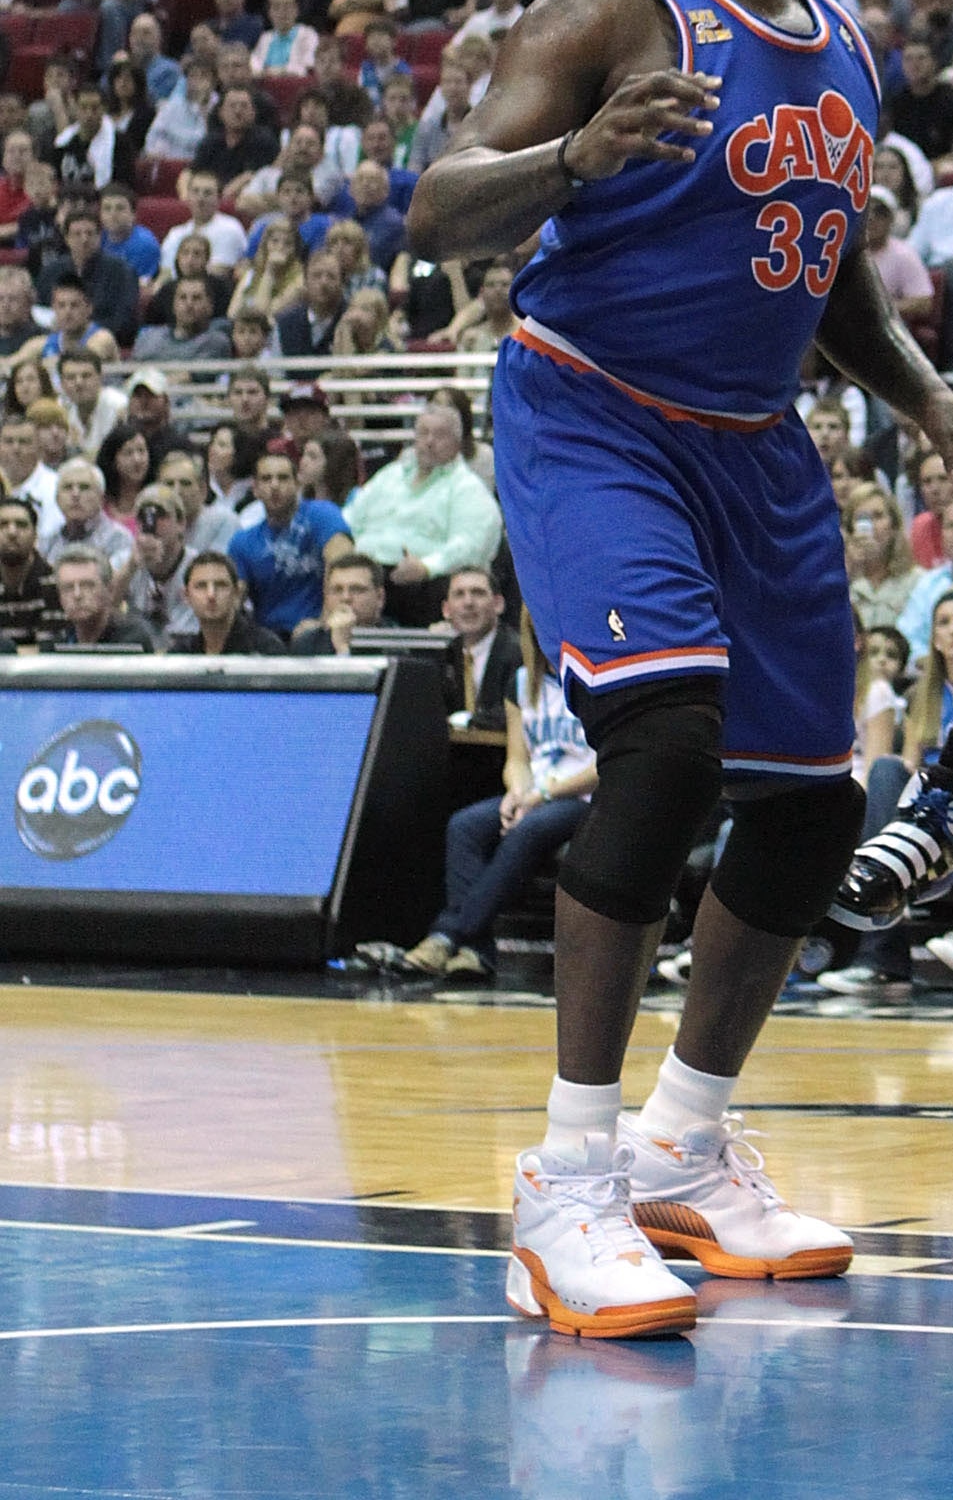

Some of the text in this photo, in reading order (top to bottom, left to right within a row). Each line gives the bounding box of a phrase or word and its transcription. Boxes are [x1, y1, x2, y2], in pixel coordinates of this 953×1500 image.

[726, 90, 875, 212] CAVS
[751, 200, 848, 298] 33
[17, 748, 140, 815] abc
